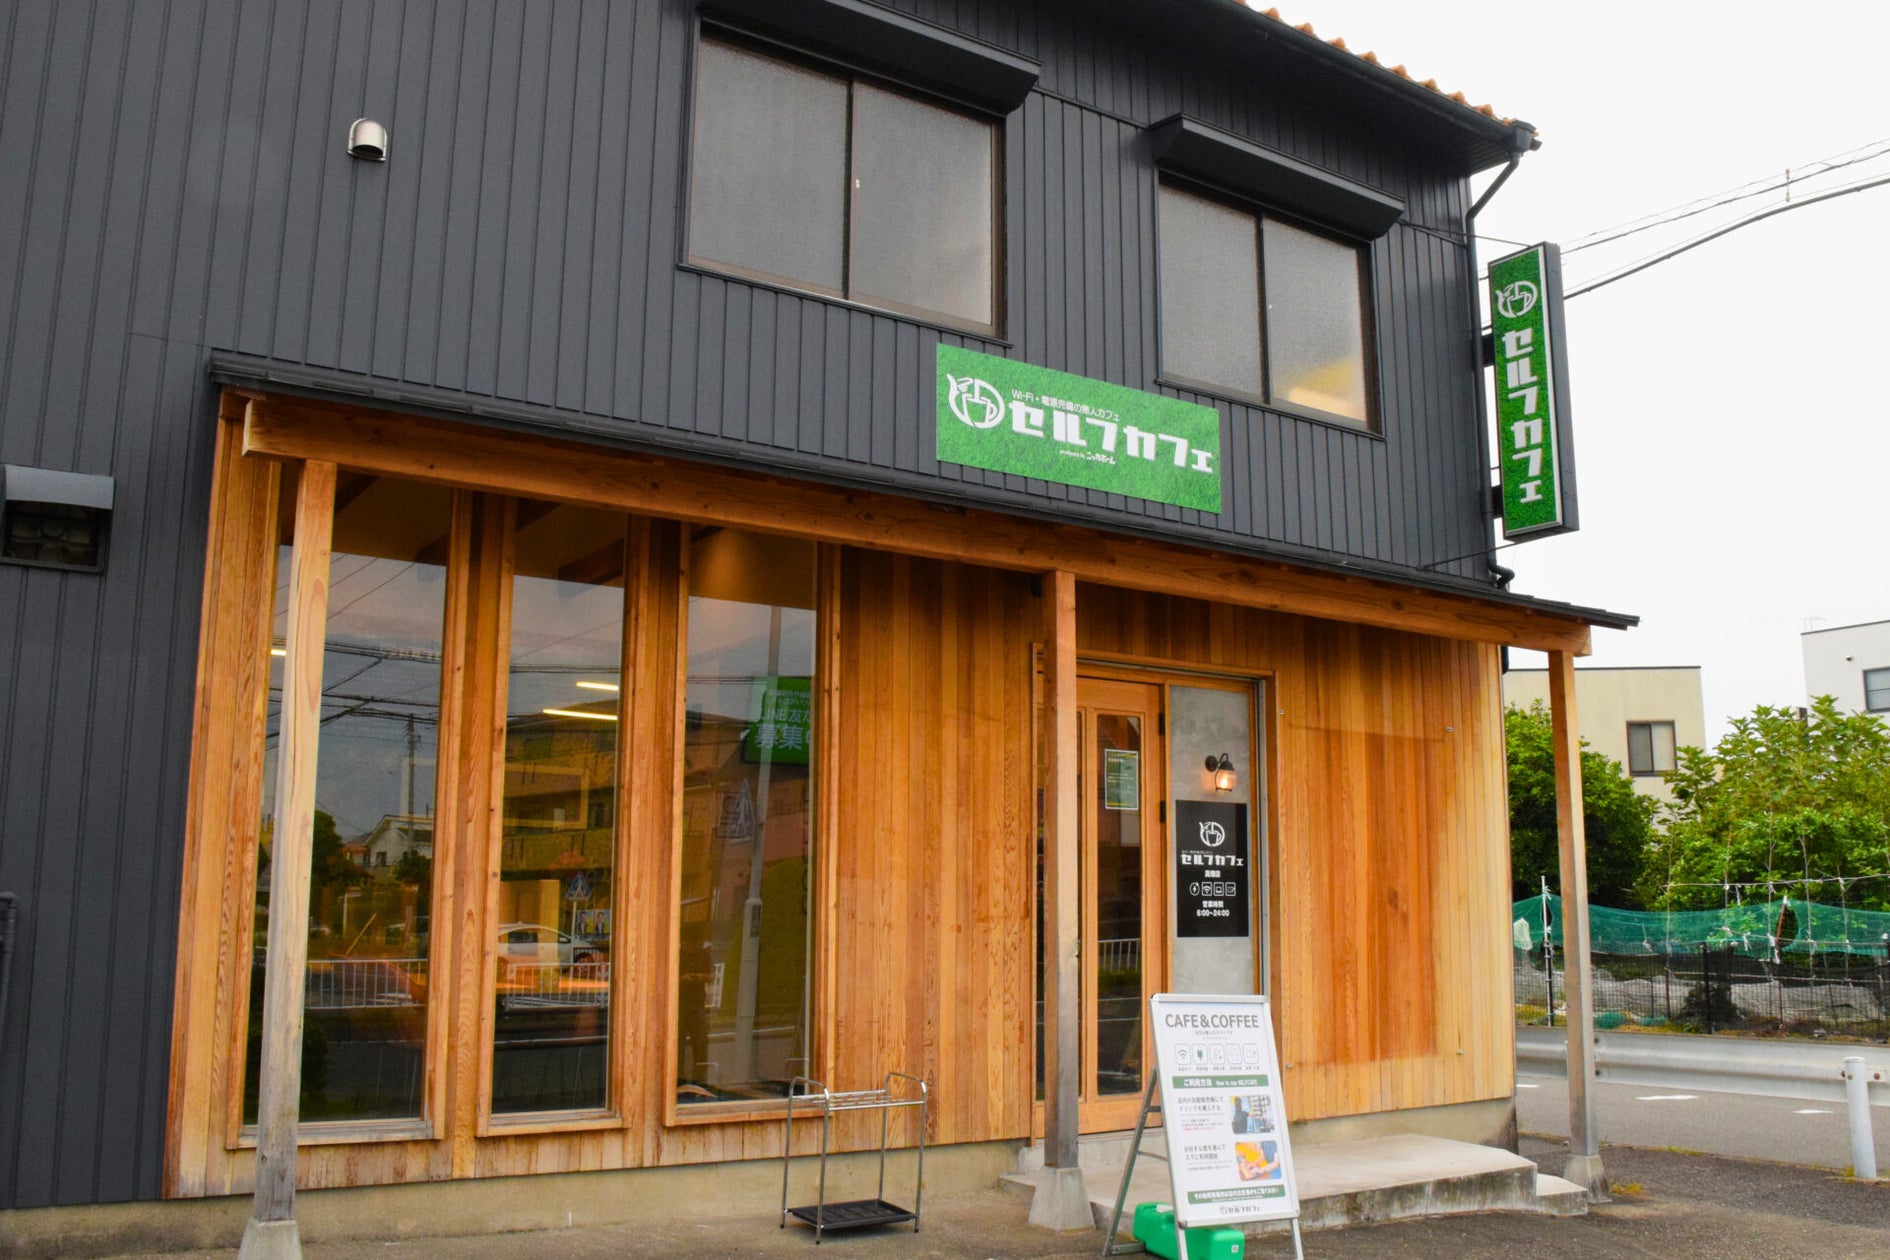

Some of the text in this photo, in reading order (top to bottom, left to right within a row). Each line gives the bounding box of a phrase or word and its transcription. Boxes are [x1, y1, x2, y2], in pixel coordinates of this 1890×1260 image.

[1502, 329, 1543, 502] セルフカフェ
[1009, 402, 1212, 473] セルフカフェ
[1181, 853, 1244, 866] セルフカフェ
[1165, 1013, 1260, 1028] CAFE&COFFEE
